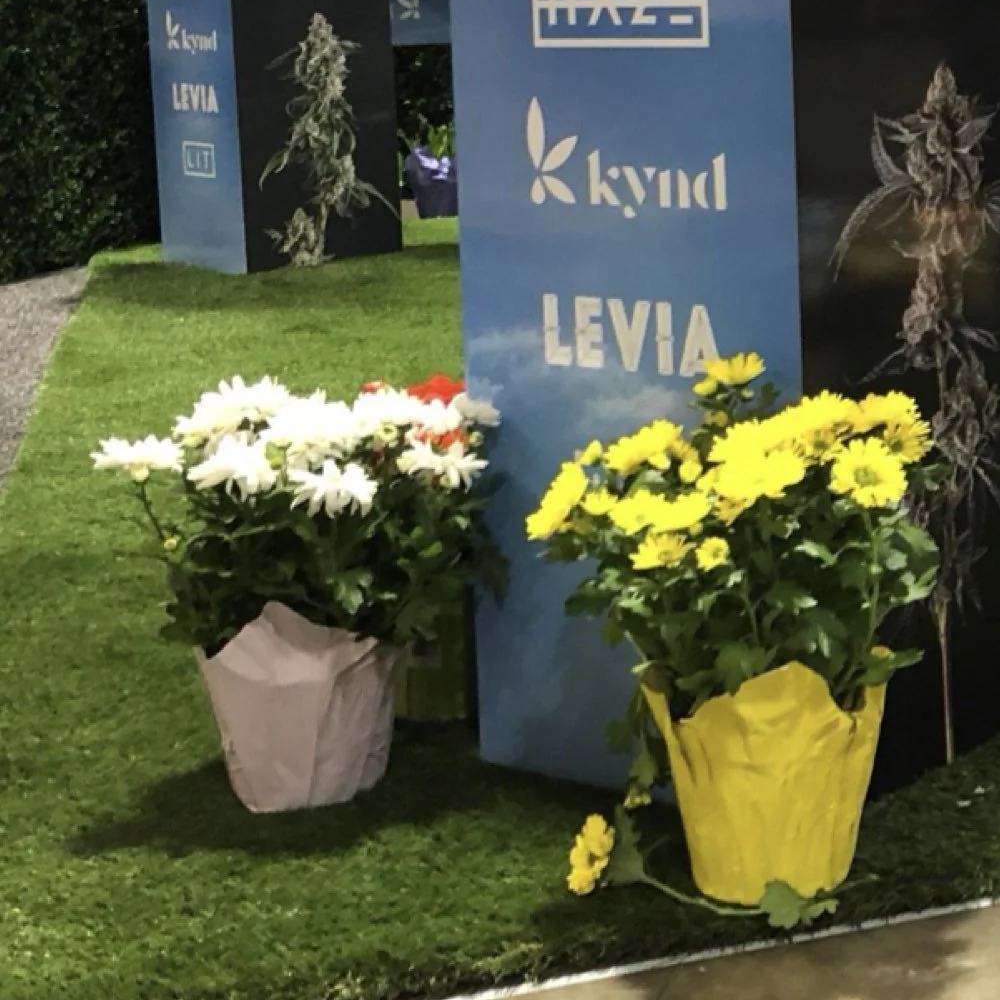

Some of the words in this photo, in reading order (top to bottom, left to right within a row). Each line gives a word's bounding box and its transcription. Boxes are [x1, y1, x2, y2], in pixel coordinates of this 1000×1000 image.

[172, 82, 220, 114] LEVIA
[186, 148, 212, 169] LIT
[587, 148, 728, 219] kynd
[542, 293, 722, 378] LEVIA
